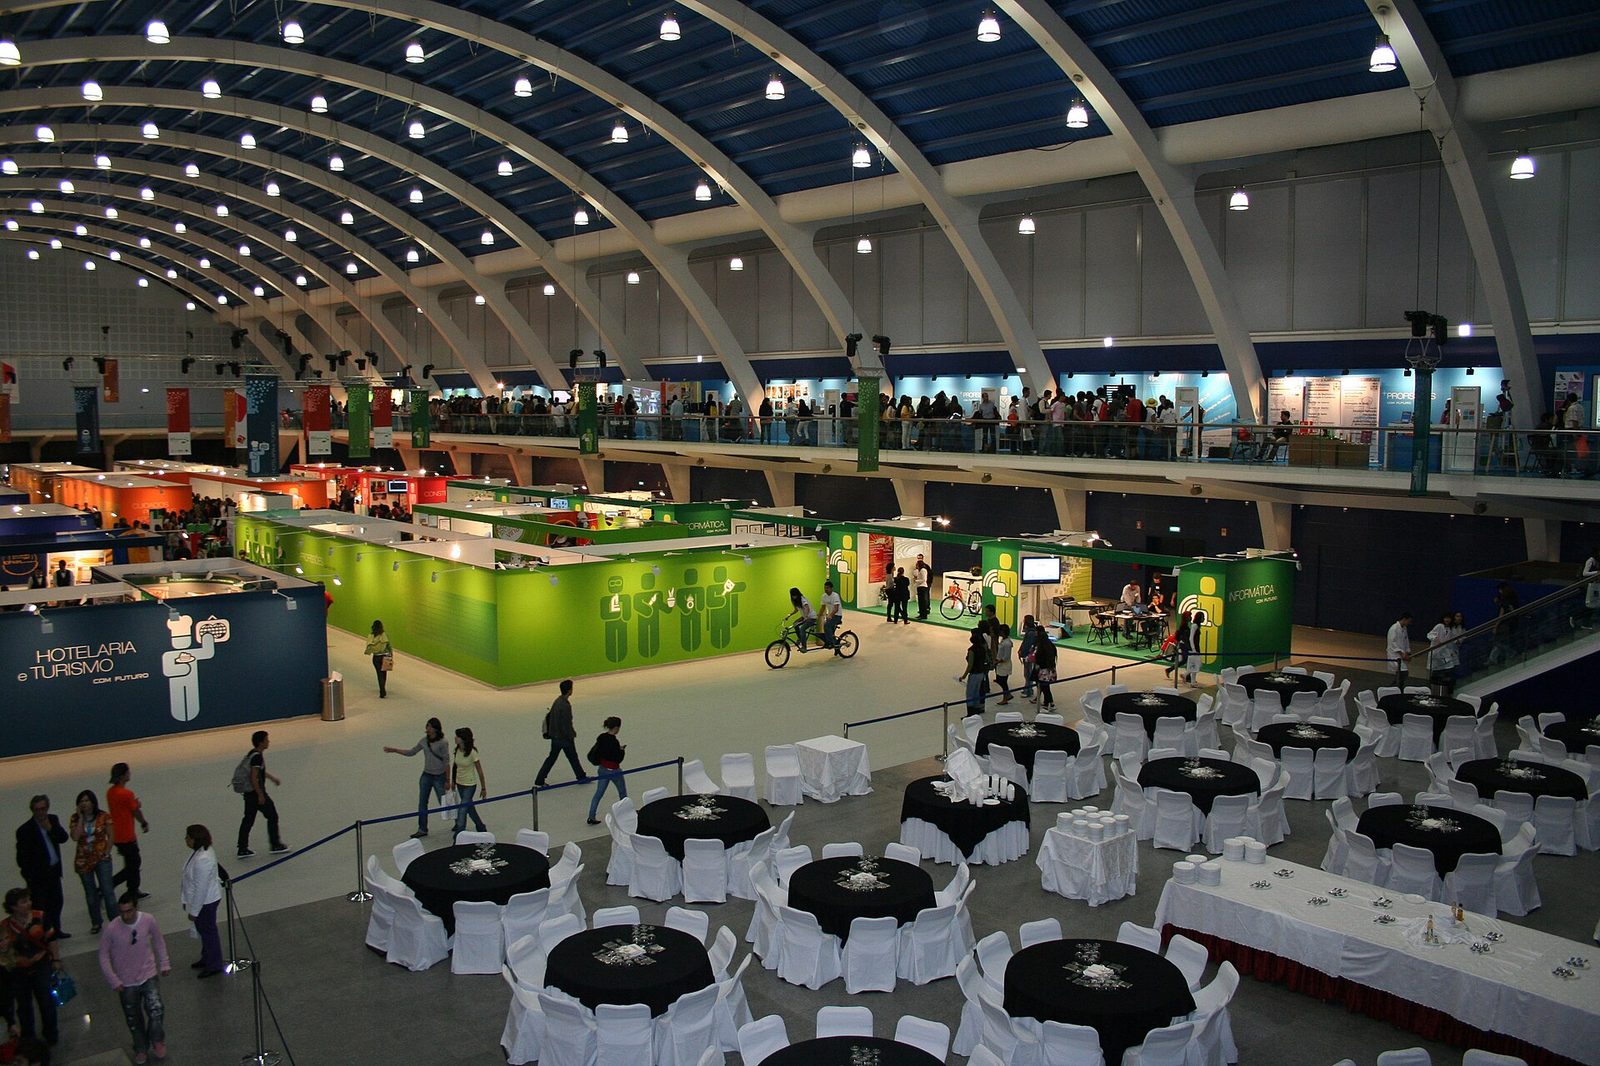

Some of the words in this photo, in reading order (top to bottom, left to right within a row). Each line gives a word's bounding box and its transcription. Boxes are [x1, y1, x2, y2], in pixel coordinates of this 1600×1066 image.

[1229, 585, 1275, 602] INFORMÁTICA
[36, 640, 137, 663] HOTELARIA
[17, 672, 28, 682] e
[30, 658, 114, 680] TURISMO
[92, 676, 112, 685] COM
[114, 672, 149, 682] FUTURO
